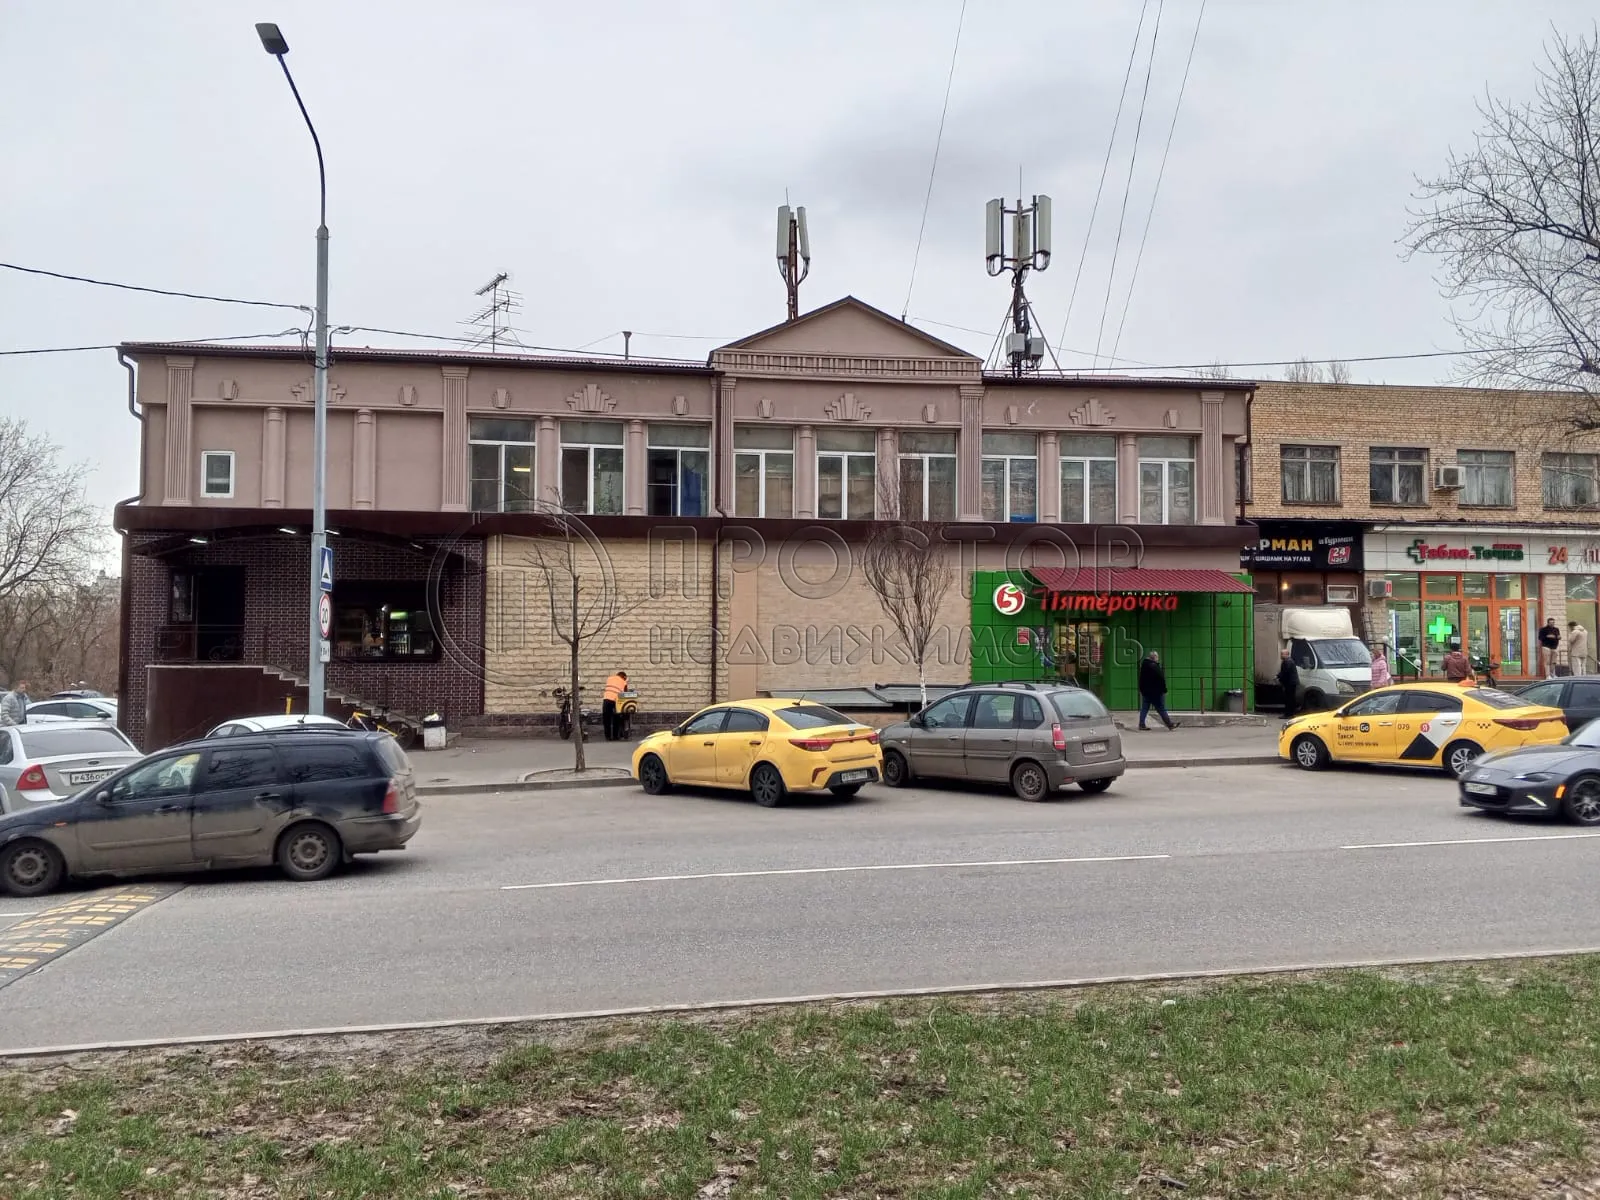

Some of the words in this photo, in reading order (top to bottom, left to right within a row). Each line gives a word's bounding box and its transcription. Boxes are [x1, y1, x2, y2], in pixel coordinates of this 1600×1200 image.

[1244, 538, 1313, 551] РМАН
[1333, 547, 1346, 557] 24
[1547, 546, 1568, 564] 24
[322, 608, 329, 624] 20
